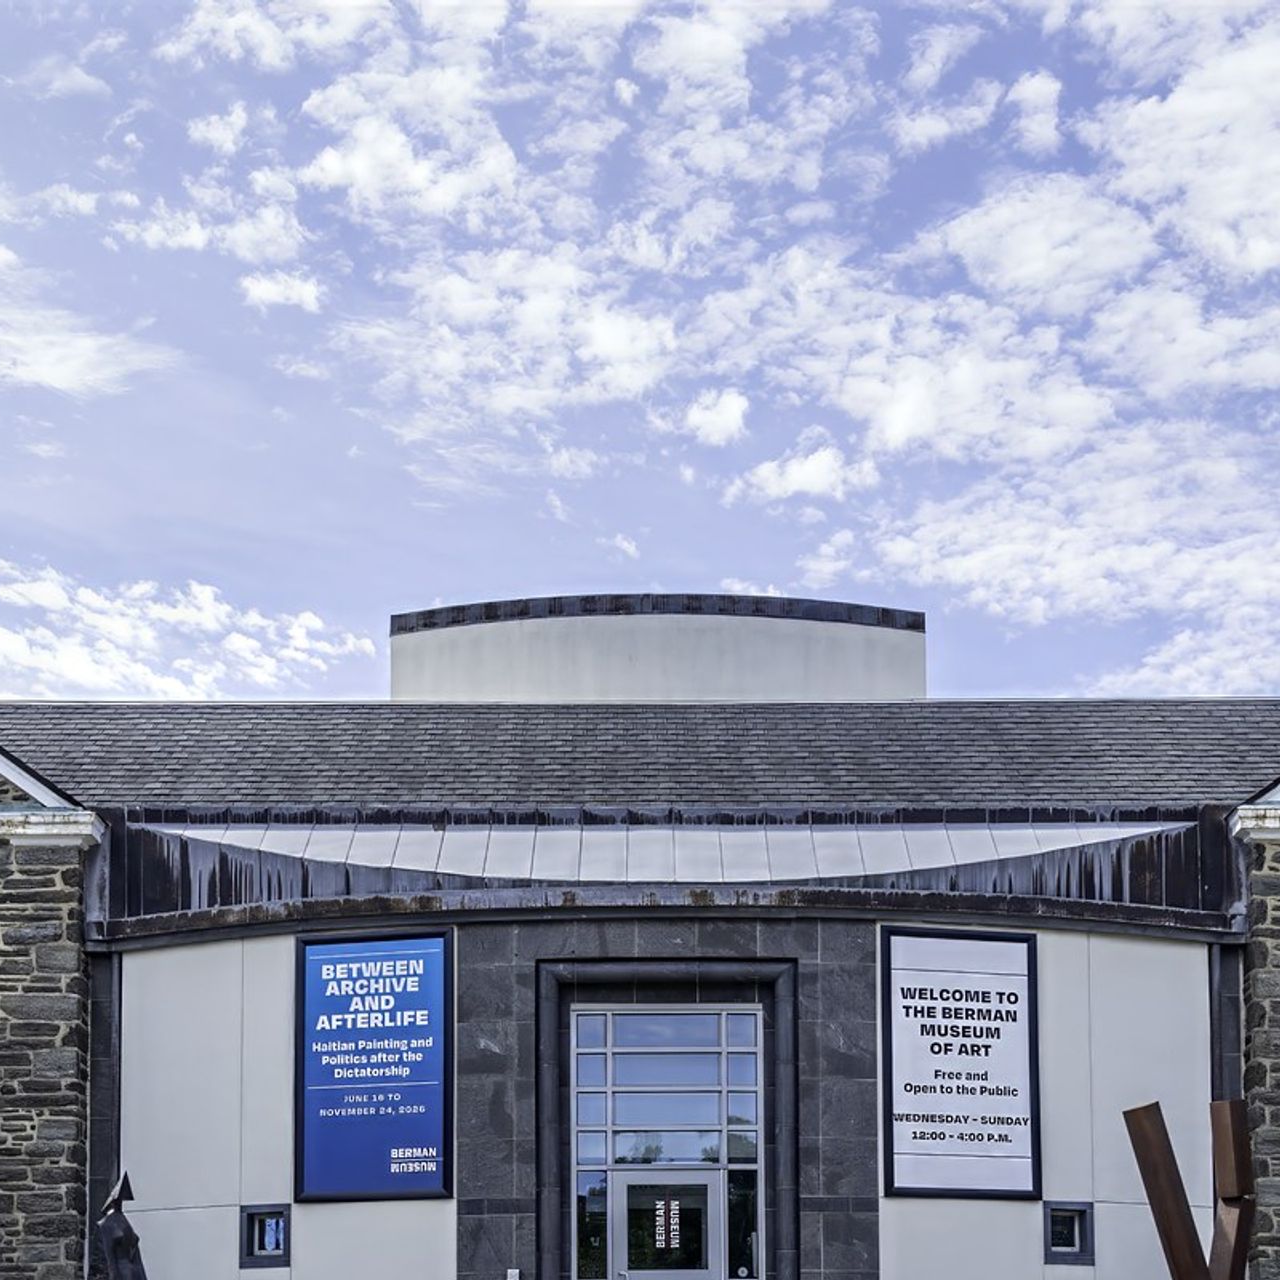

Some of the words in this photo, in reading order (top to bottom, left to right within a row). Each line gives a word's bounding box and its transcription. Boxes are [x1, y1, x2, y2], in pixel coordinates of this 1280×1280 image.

[321, 960, 424, 980] BETWEEN
[326, 977, 419, 996] ARCHIVE
[349, 995, 395, 1012] AND
[900, 987, 991, 1004] WELCOME
[996, 991, 1019, 1005] TO
[316, 1011, 429, 1031] AFTERLIFE
[902, 1005, 937, 1019] THE
[941, 1007, 1017, 1022] BERMAN
[919, 1024, 1001, 1040] MUSEUM
[312, 1041, 355, 1053] Haitian
[358, 1038, 408, 1050] Painting
[410, 1037, 433, 1048] and
[930, 1042, 953, 1055] OF
[957, 1043, 992, 1057] ART
[321, 1055, 368, 1065] Politics
[370, 1053, 400, 1063] after
[402, 1051, 423, 1062] the
[334, 1066, 410, 1079] Dictatorship
[934, 1070, 962, 1081] Free
[965, 1071, 988, 1082] and
[903, 1083, 937, 1095] Open
[939, 1084, 953, 1094] to
[956, 1084, 977, 1096] the
[979, 1086, 1018, 1097] Public
[344, 1095, 369, 1103] JUNE
[388, 1093, 401, 1101] TO
[320, 1107, 376, 1116] NOVEMBER
[893, 1113, 970, 1125] WEDNESDAY
[980, 1115, 1029, 1126] SUNDAY
[912, 1131, 946, 1141] 12:00
[957, 1132, 984, 1142] 4:00
[986, 1133, 1012, 1143] P.M.
[390, 1147, 436, 1158] BERMAN
[390, 1162, 436, 1173] MUSEUM
[656, 1201, 665, 1248] BERMAN
[670, 1201, 680, 1248] MUSEUM
